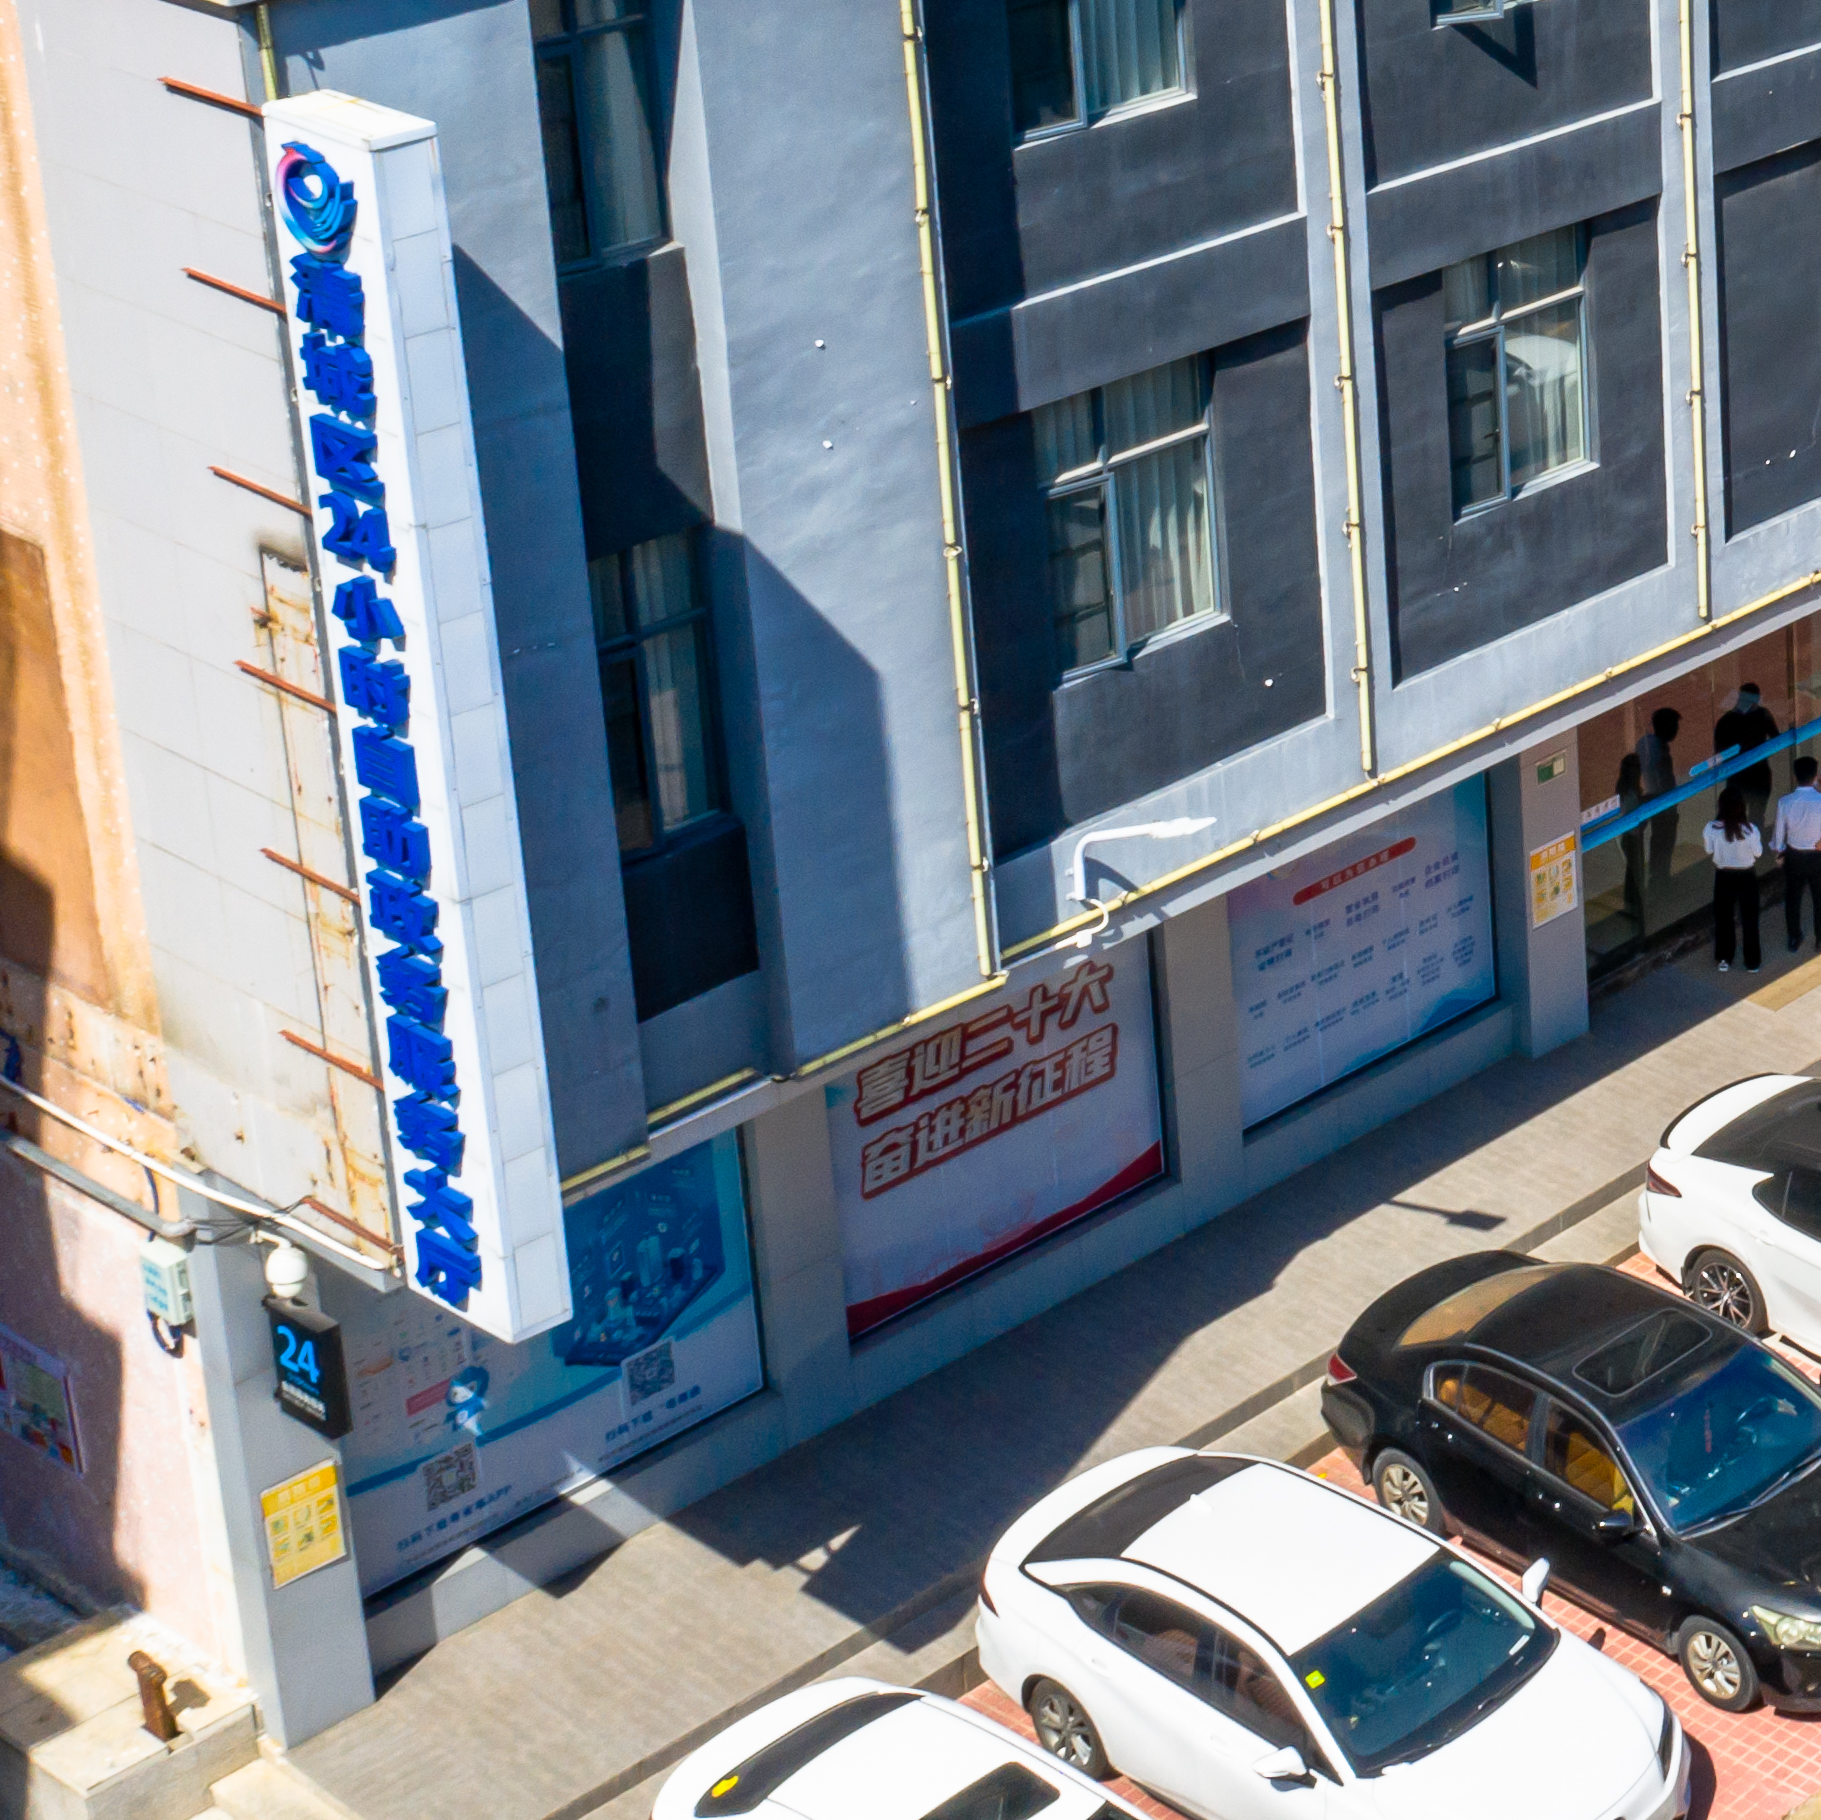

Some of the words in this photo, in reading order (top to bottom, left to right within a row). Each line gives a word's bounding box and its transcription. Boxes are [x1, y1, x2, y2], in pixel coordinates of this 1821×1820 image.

[288, 251, 484, 1312] 清城区24小时自助政务服务大厅
[856, 959, 1116, 1128] 喜迎二十大
[859, 1021, 1120, 1201] 奋进新征程
[276, 1324, 321, 1384] 24
